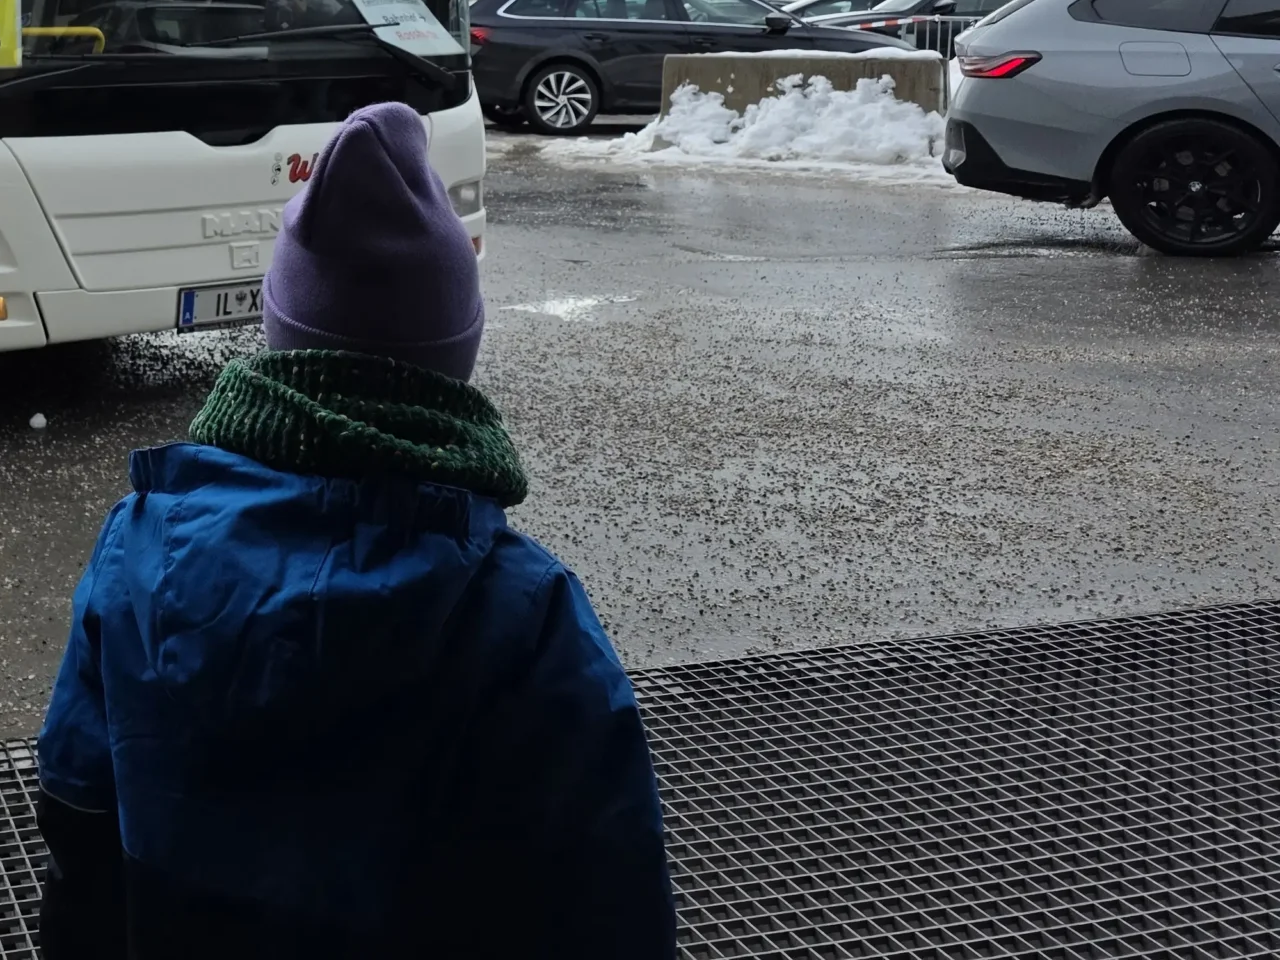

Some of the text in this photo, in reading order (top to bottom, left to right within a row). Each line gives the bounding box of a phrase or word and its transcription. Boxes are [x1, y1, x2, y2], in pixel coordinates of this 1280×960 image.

[287, 152, 320, 183] W
[201, 208, 284, 239] MAN
[216, 292, 232, 316] IL
[248, 288, 264, 313] X
